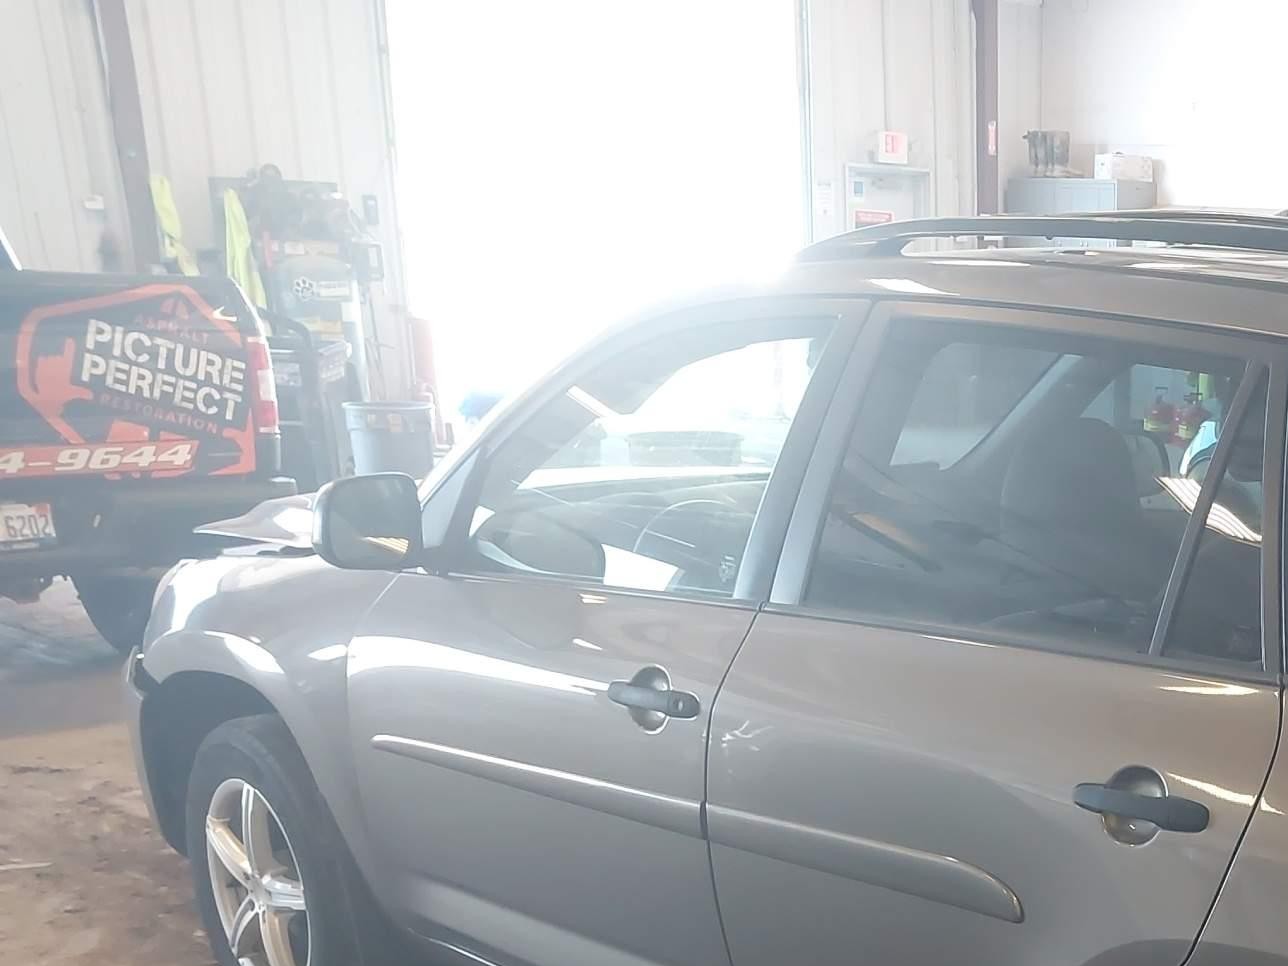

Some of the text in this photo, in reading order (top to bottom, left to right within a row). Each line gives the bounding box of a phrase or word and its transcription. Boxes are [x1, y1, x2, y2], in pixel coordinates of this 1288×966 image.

[81, 352, 243, 421] PERFECT
[85, 318, 247, 392] PICTURE
[99, 393, 219, 434] RESTORATION
